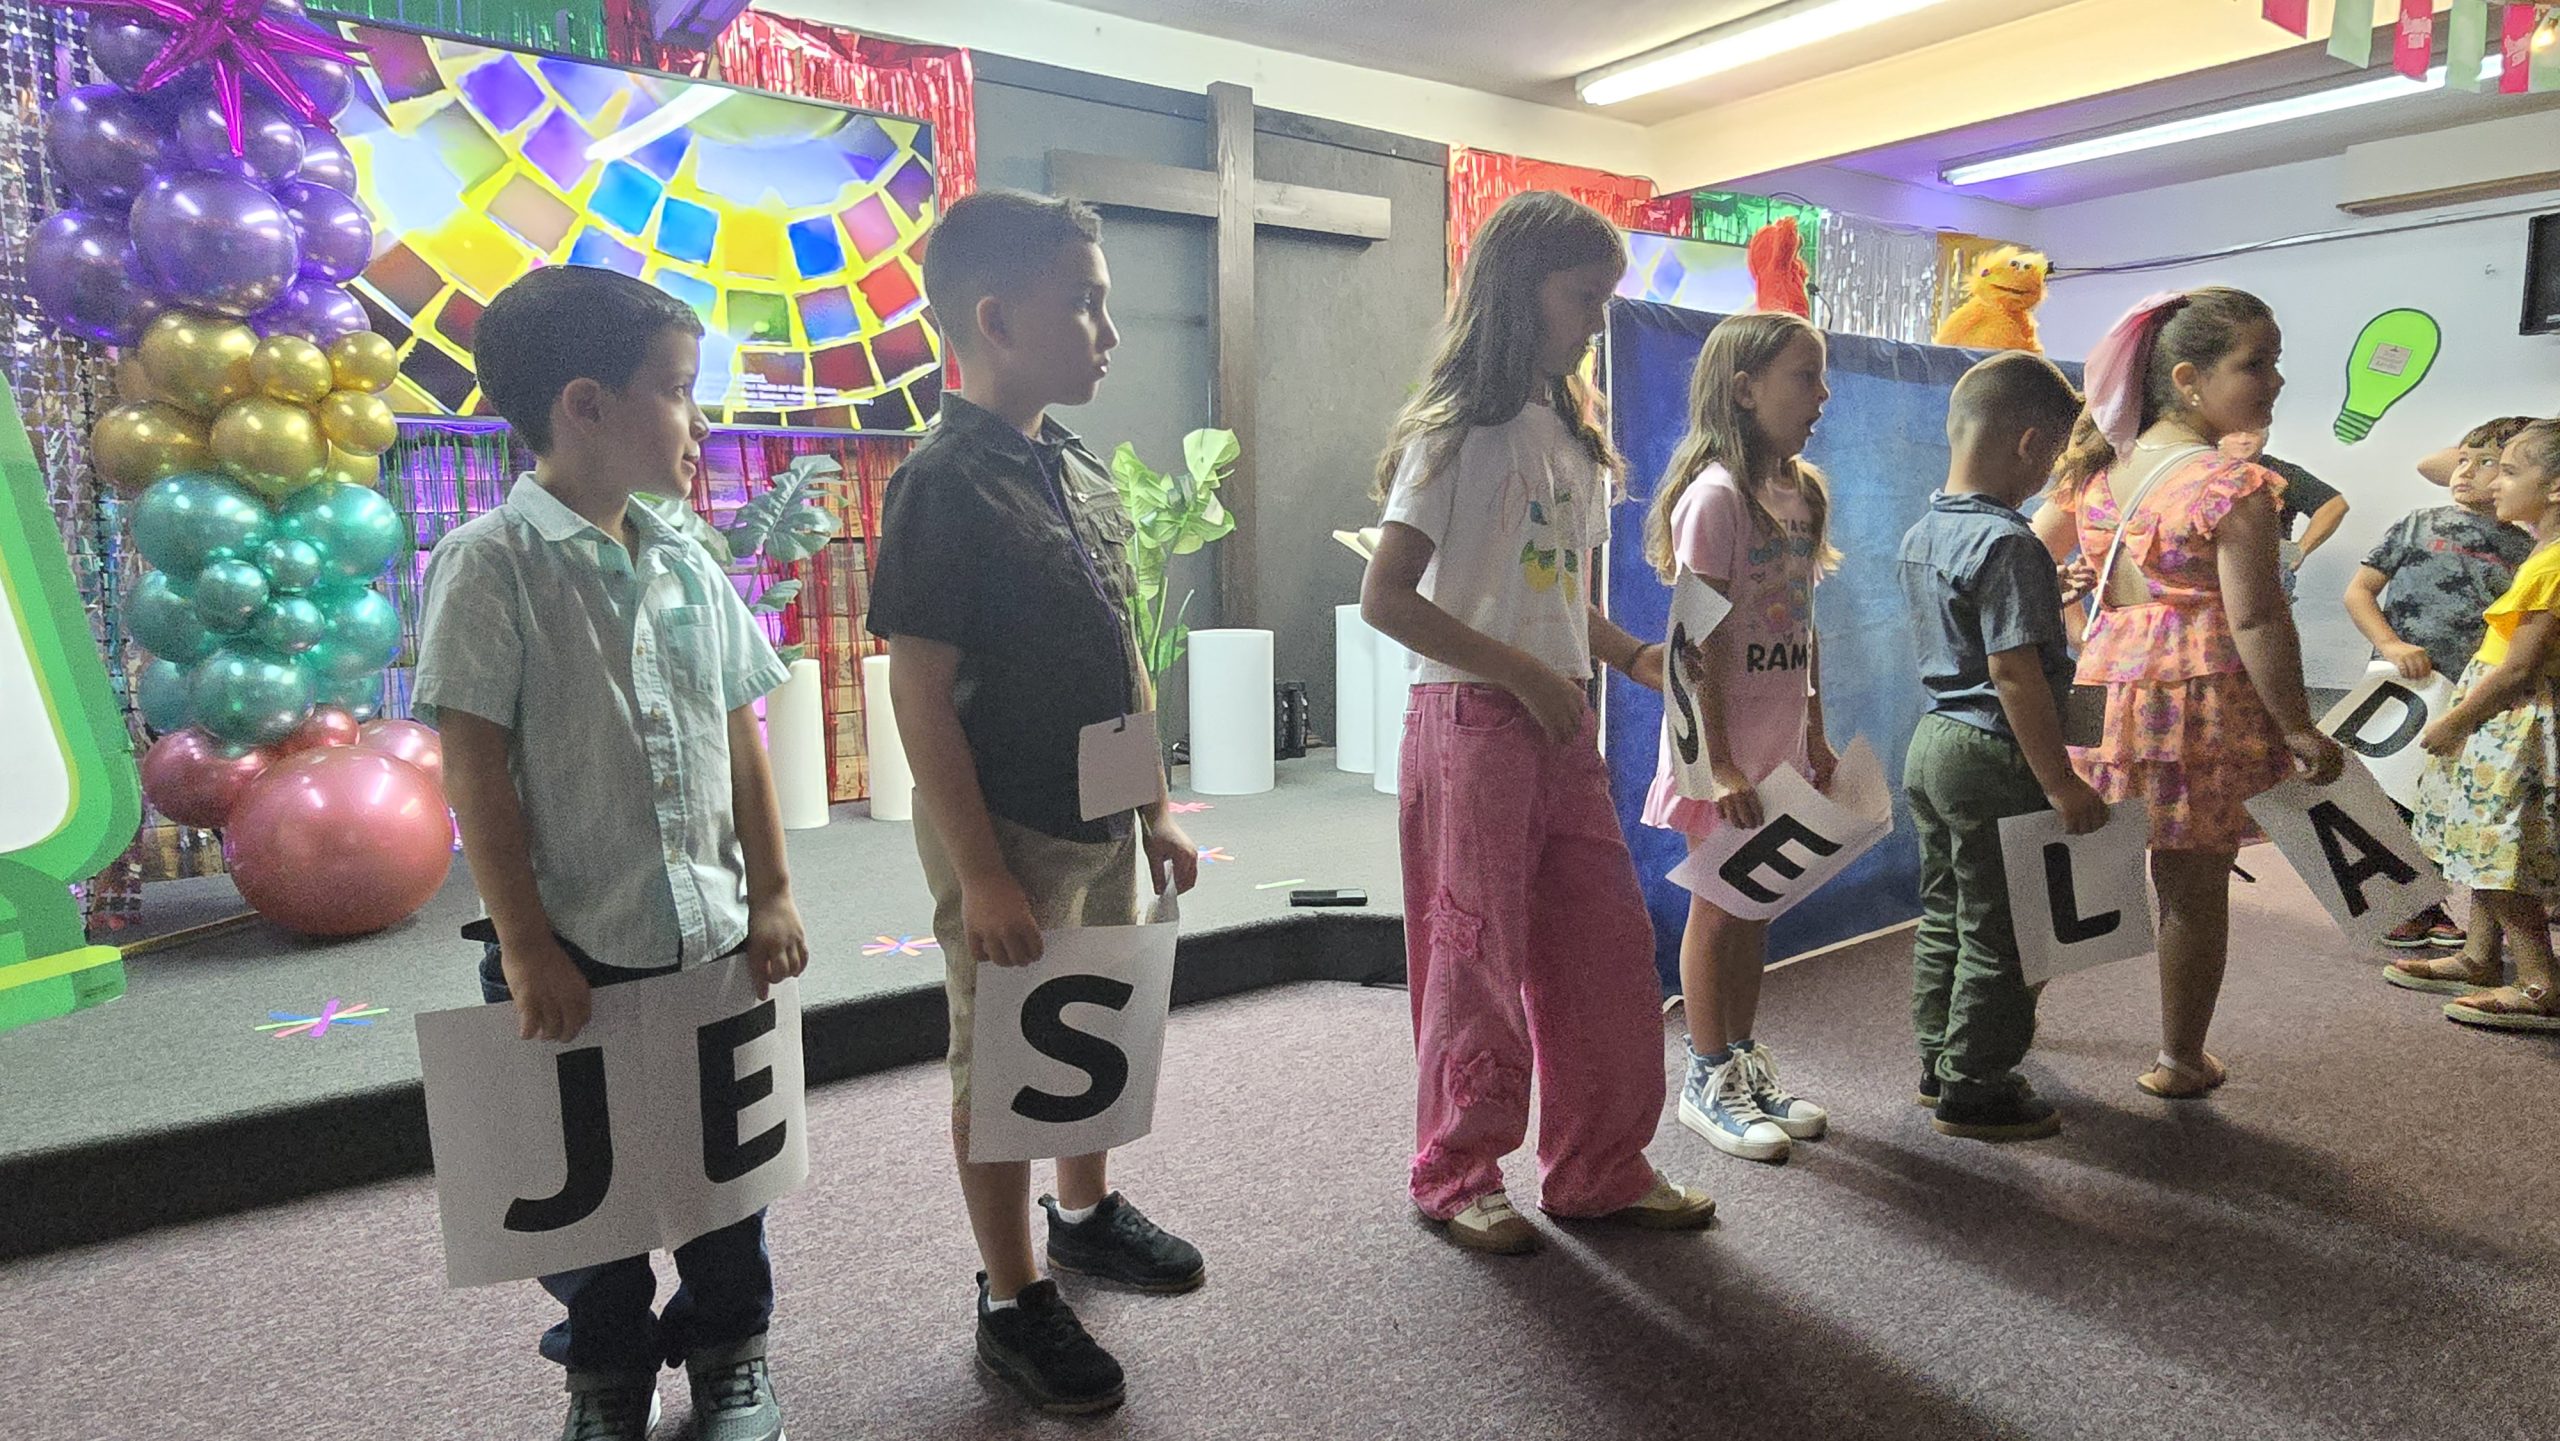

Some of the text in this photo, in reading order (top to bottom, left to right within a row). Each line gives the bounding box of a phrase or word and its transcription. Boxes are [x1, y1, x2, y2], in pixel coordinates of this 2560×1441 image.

[2331, 679, 2429, 758] D
[1718, 813, 1843, 904] E
[2042, 841, 2122, 945] L
[2307, 799, 2420, 919] A
[696, 999, 786, 1184] E
[1010, 974, 1134, 1123] S
[503, 1045, 613, 1232] J
